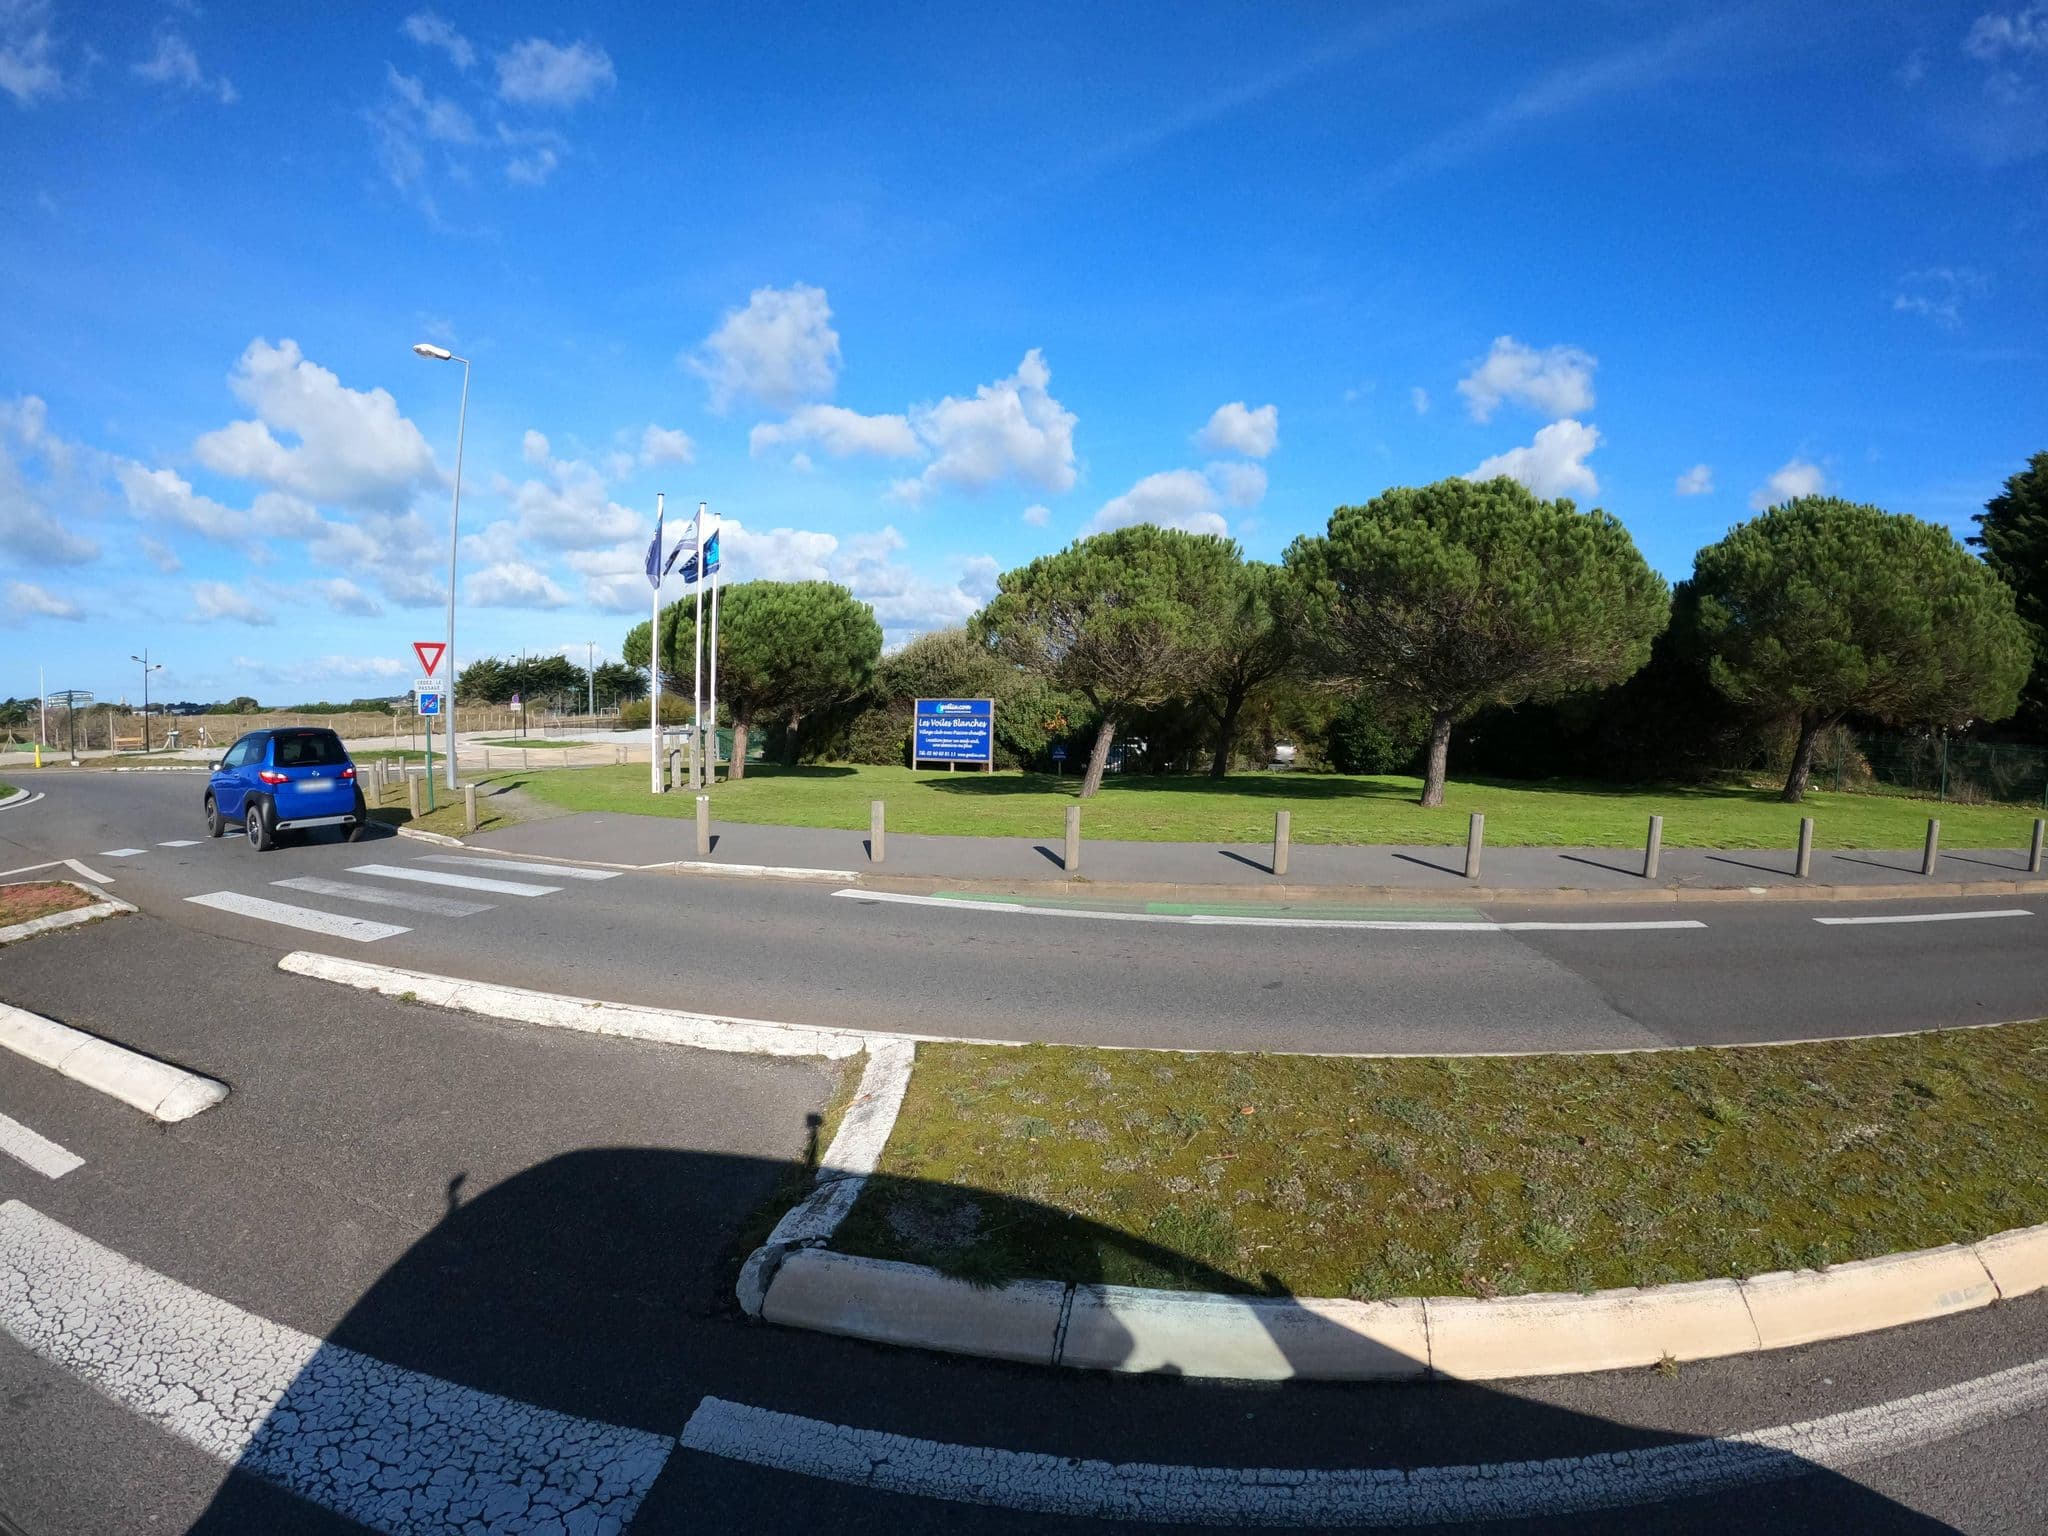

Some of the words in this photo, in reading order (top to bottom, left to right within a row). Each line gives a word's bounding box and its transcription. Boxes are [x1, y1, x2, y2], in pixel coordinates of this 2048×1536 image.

[919, 719, 930, 727] Les
[931, 719, 952, 727] Voiles
[952, 719, 987, 728] Blanches
